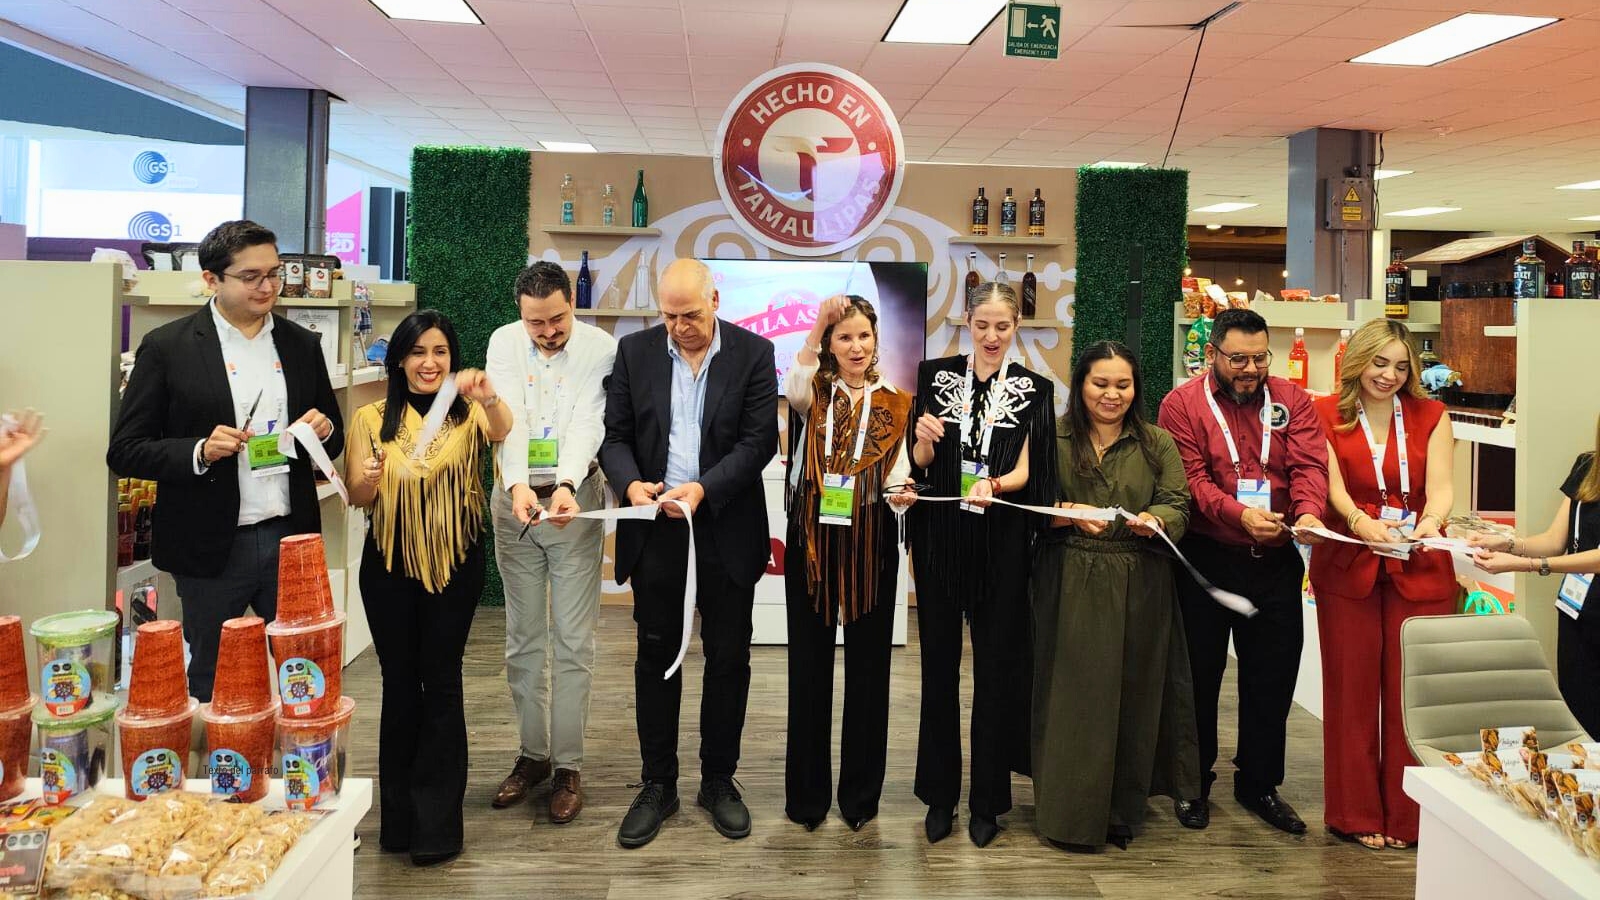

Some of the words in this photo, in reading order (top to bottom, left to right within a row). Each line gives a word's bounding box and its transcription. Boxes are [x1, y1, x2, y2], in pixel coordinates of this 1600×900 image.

[749, 83, 834, 125] HECHO
[837, 93, 872, 129] EN
[148, 161, 176, 174] GS1
[737, 176, 881, 238] TAMAULIPAS
[147, 223, 182, 237] GS1
[331, 239, 355, 252] 2D
